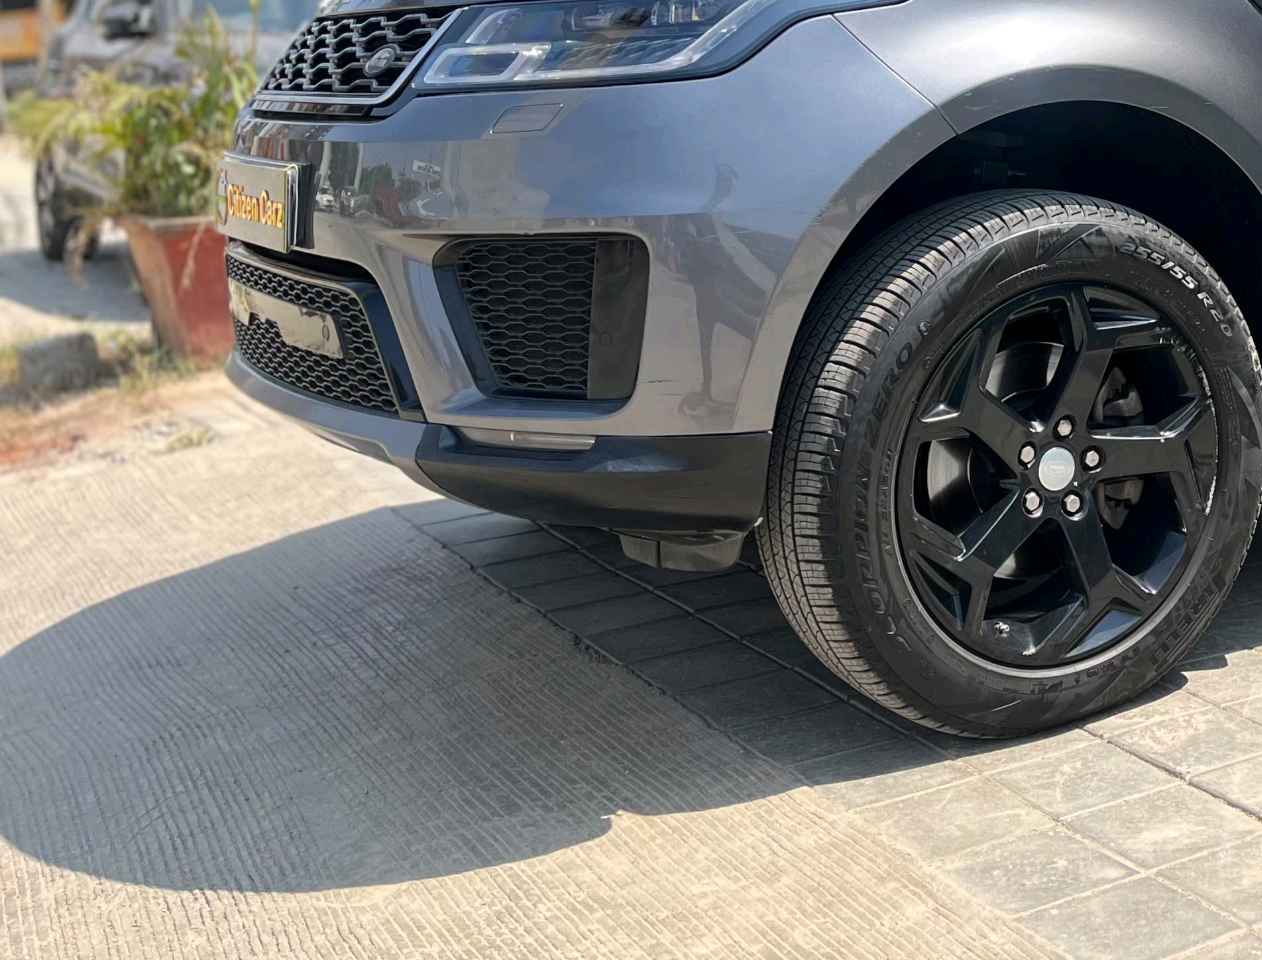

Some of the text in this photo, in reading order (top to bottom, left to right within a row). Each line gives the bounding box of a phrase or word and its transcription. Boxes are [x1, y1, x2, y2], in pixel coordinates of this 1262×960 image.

[227, 184, 283, 228] Citizen Carz
[1119, 242, 1198, 290] 255/55
